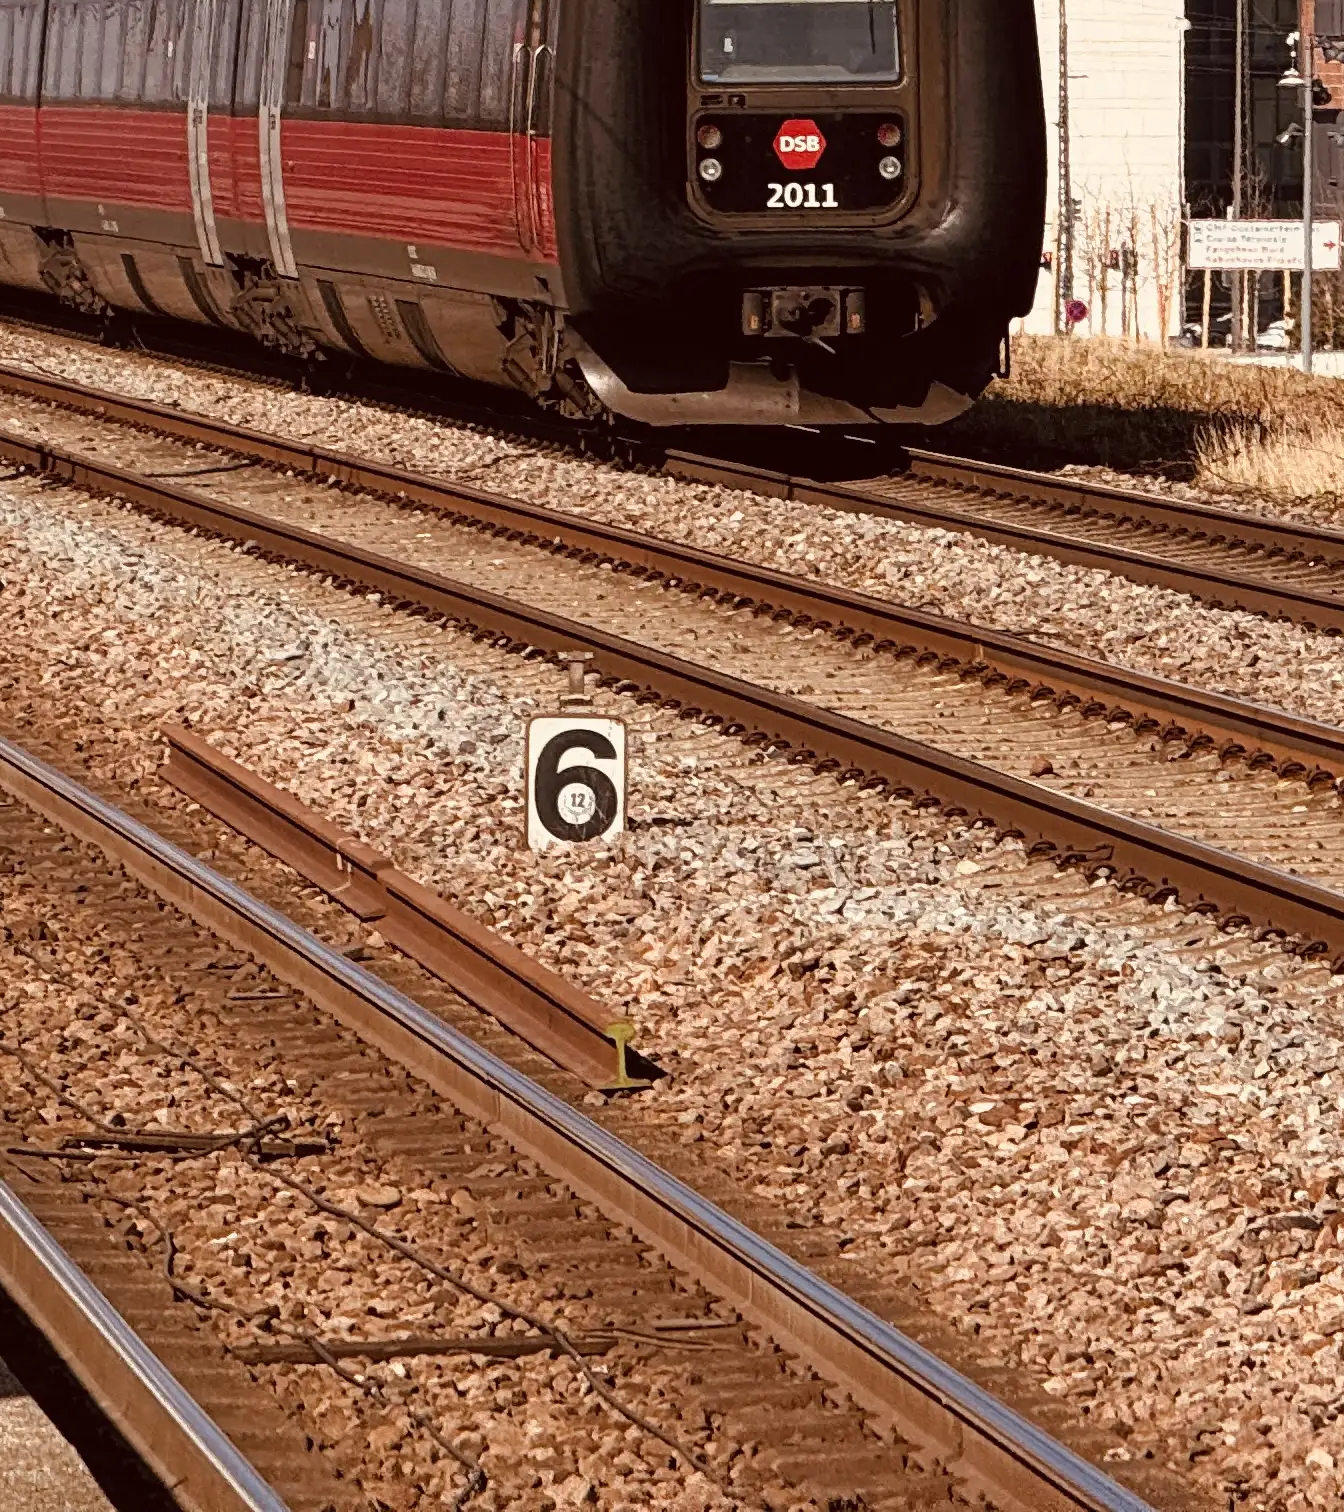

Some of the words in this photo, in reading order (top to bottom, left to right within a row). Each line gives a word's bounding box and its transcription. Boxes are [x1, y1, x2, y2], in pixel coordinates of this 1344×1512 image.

[779, 135, 820, 153] DSB
[766, 182, 839, 208] 2011
[534, 728, 618, 843] 6
[570, 792, 586, 809] 12
